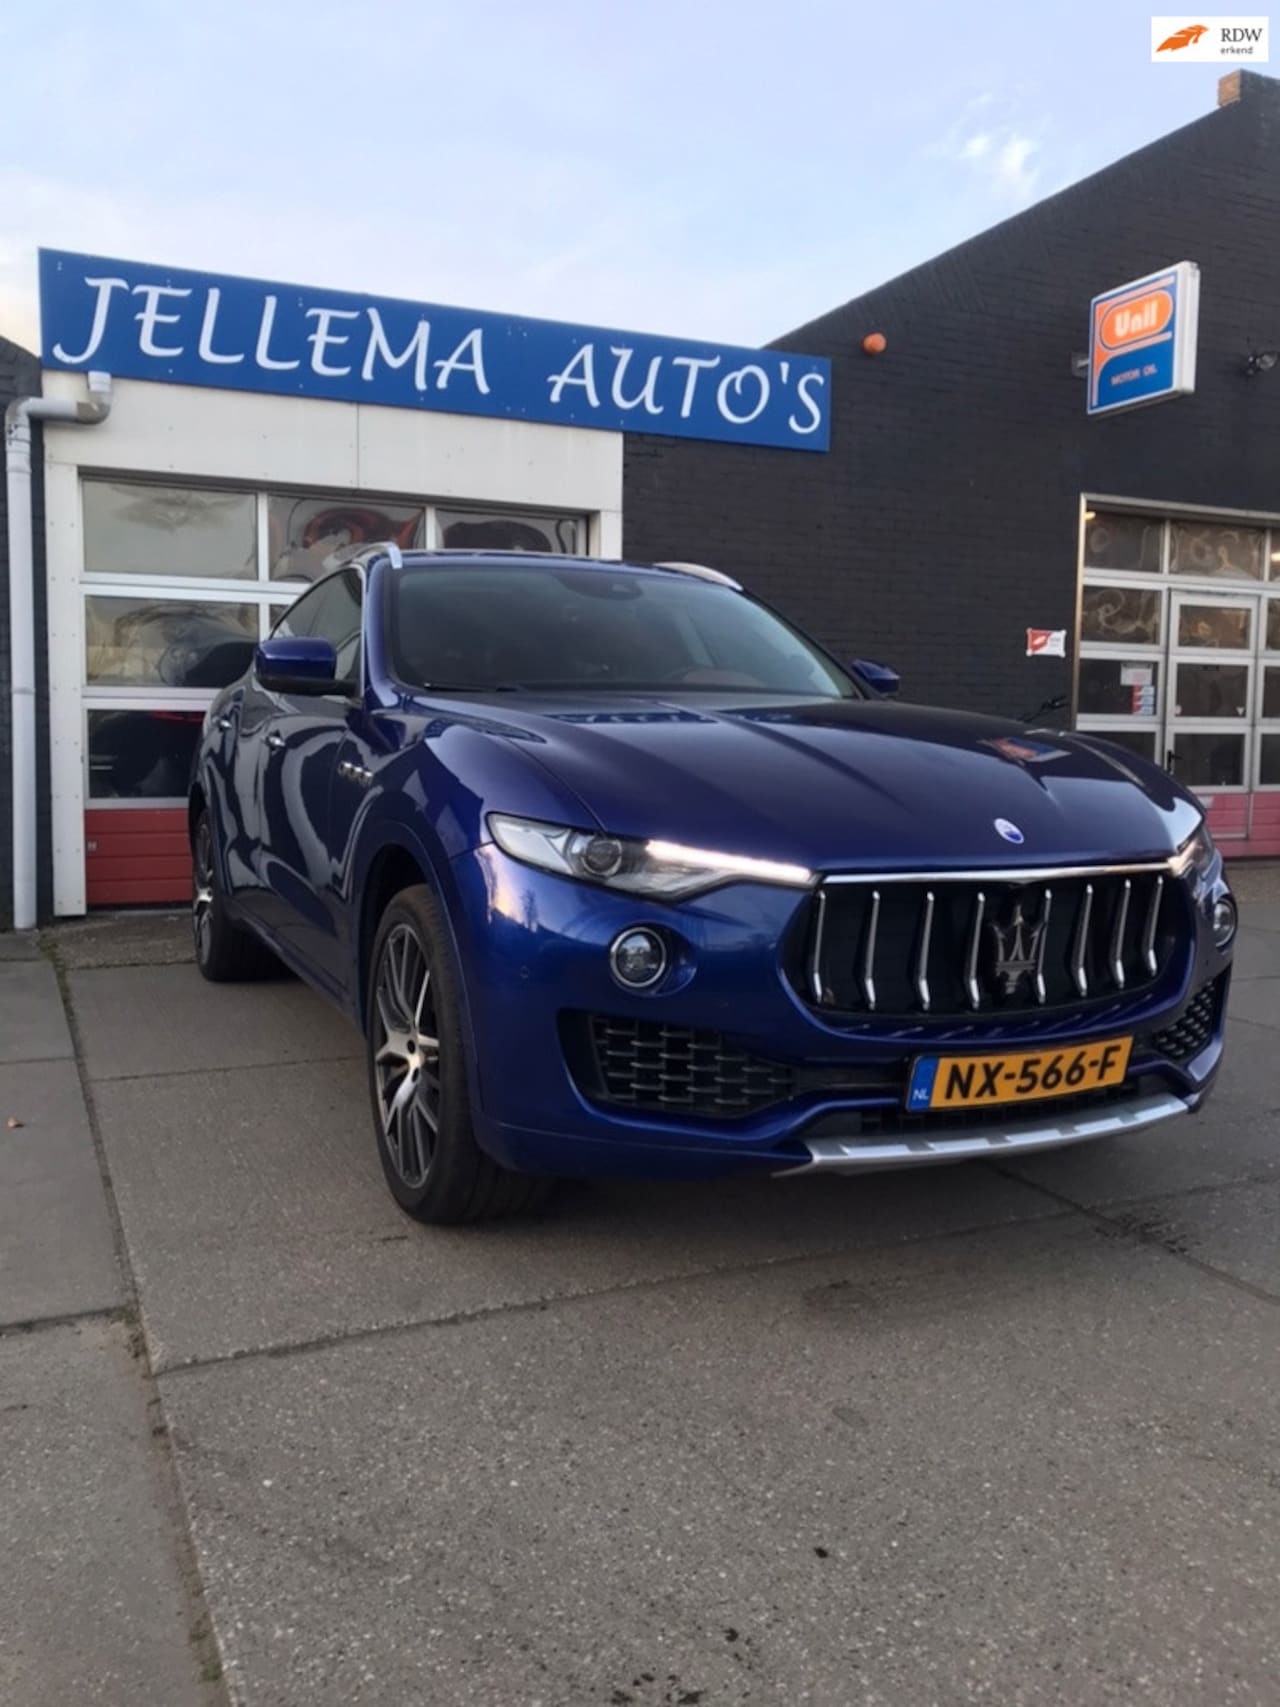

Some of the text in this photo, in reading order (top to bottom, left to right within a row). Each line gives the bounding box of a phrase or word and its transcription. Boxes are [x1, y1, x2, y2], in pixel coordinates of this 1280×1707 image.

[52, 277, 825, 435] JELLEMA AUTO'S
[912, 1088, 929, 1100] NL
[945, 1045, 1121, 1100] NX-566-F
